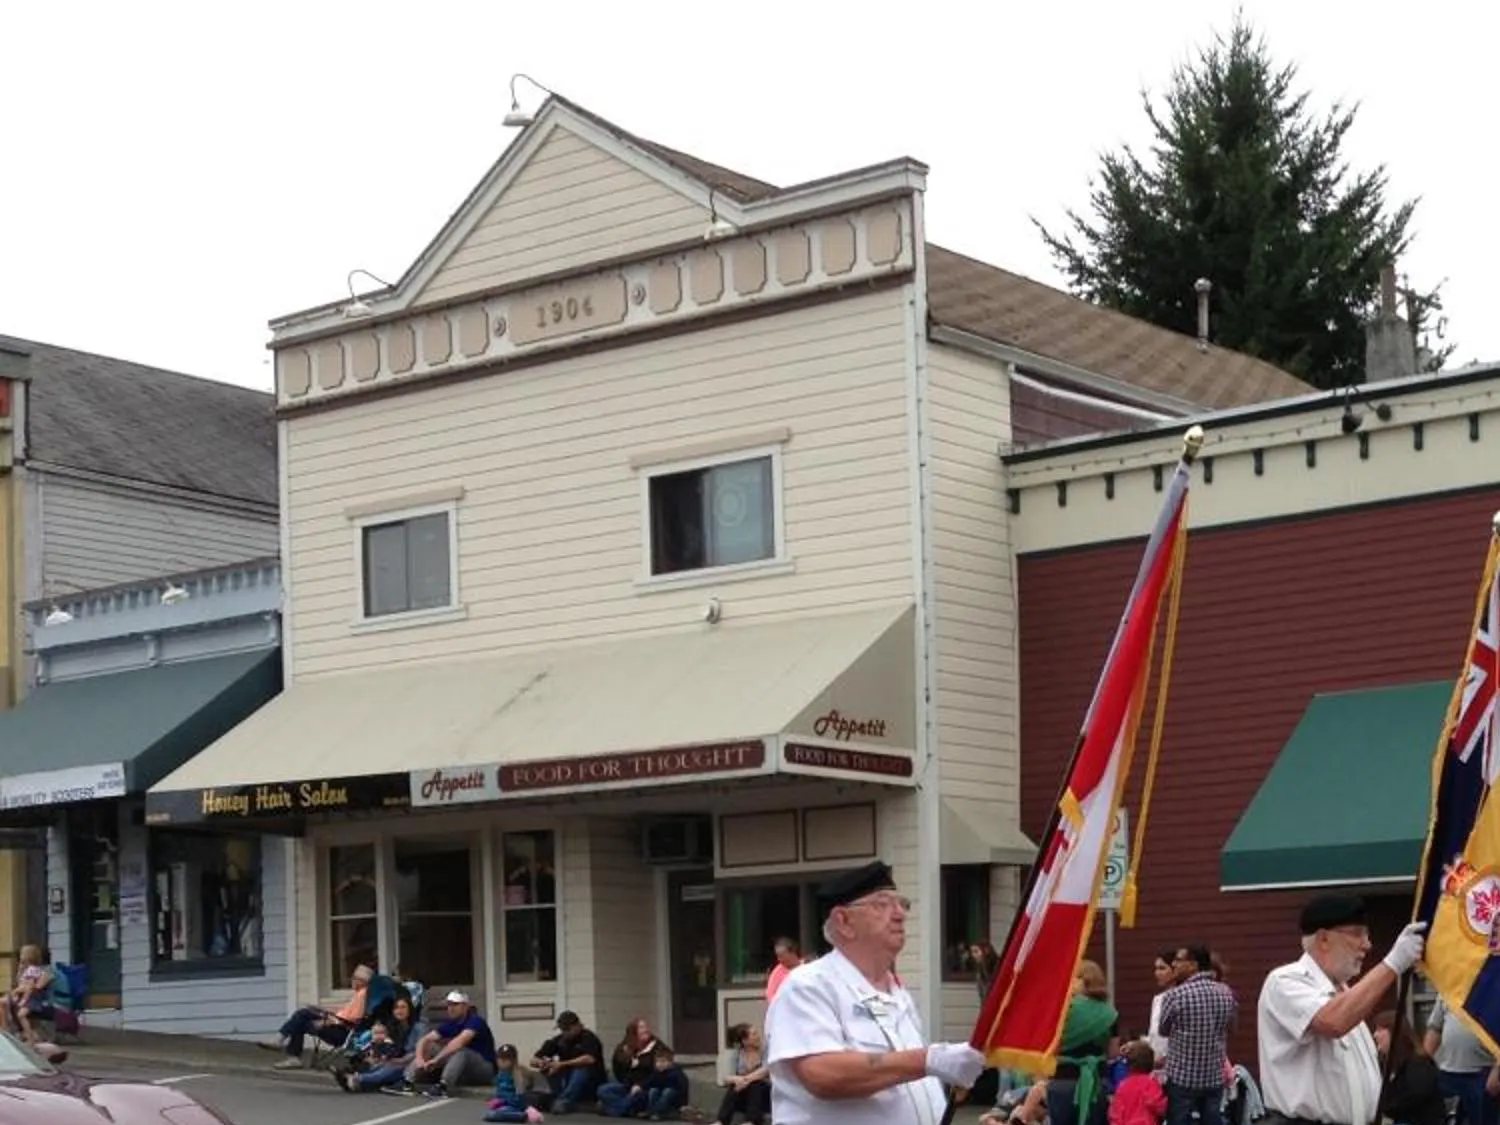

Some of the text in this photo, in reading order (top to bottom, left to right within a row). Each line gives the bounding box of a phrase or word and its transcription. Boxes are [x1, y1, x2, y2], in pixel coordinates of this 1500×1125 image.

[813, 708, 886, 741] Appetit
[512, 747, 751, 786] FOOD FOR THOUGHT
[202, 790, 248, 815] Honey
[256, 785, 293, 810] Hair
[421, 767, 486, 800] Appetit
